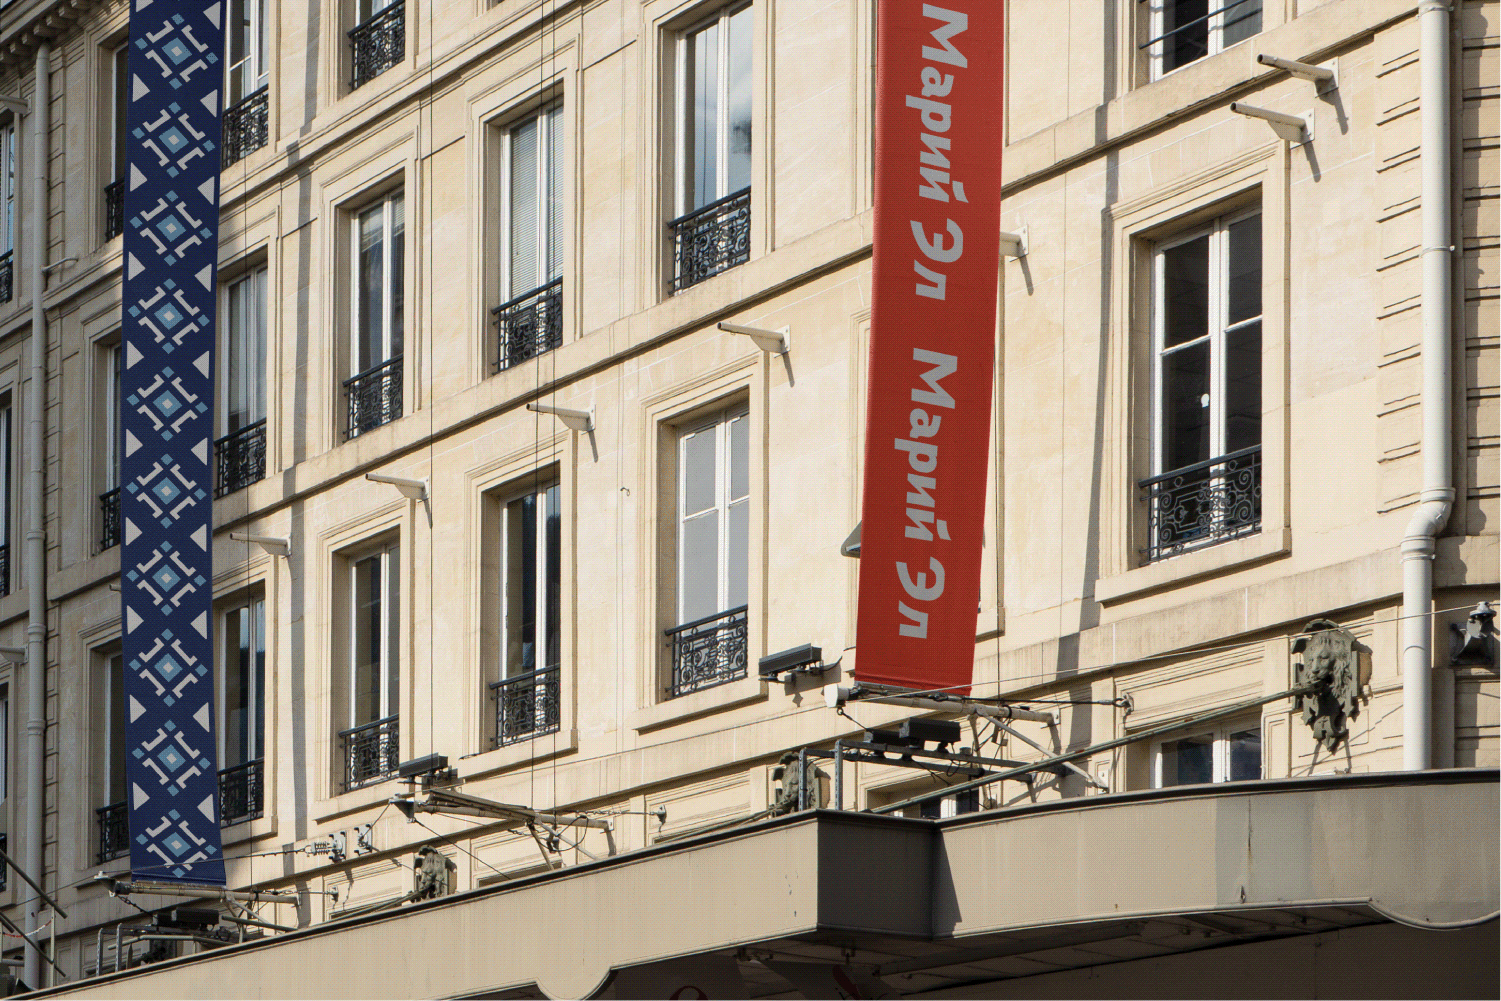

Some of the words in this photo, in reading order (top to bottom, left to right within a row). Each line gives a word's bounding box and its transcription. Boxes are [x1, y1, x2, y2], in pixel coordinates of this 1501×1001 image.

[906, 4, 968, 202] Марий
[911, 219, 963, 300] Эл
[895, 348, 957, 541] Марий
[896, 557, 945, 638] Эл
